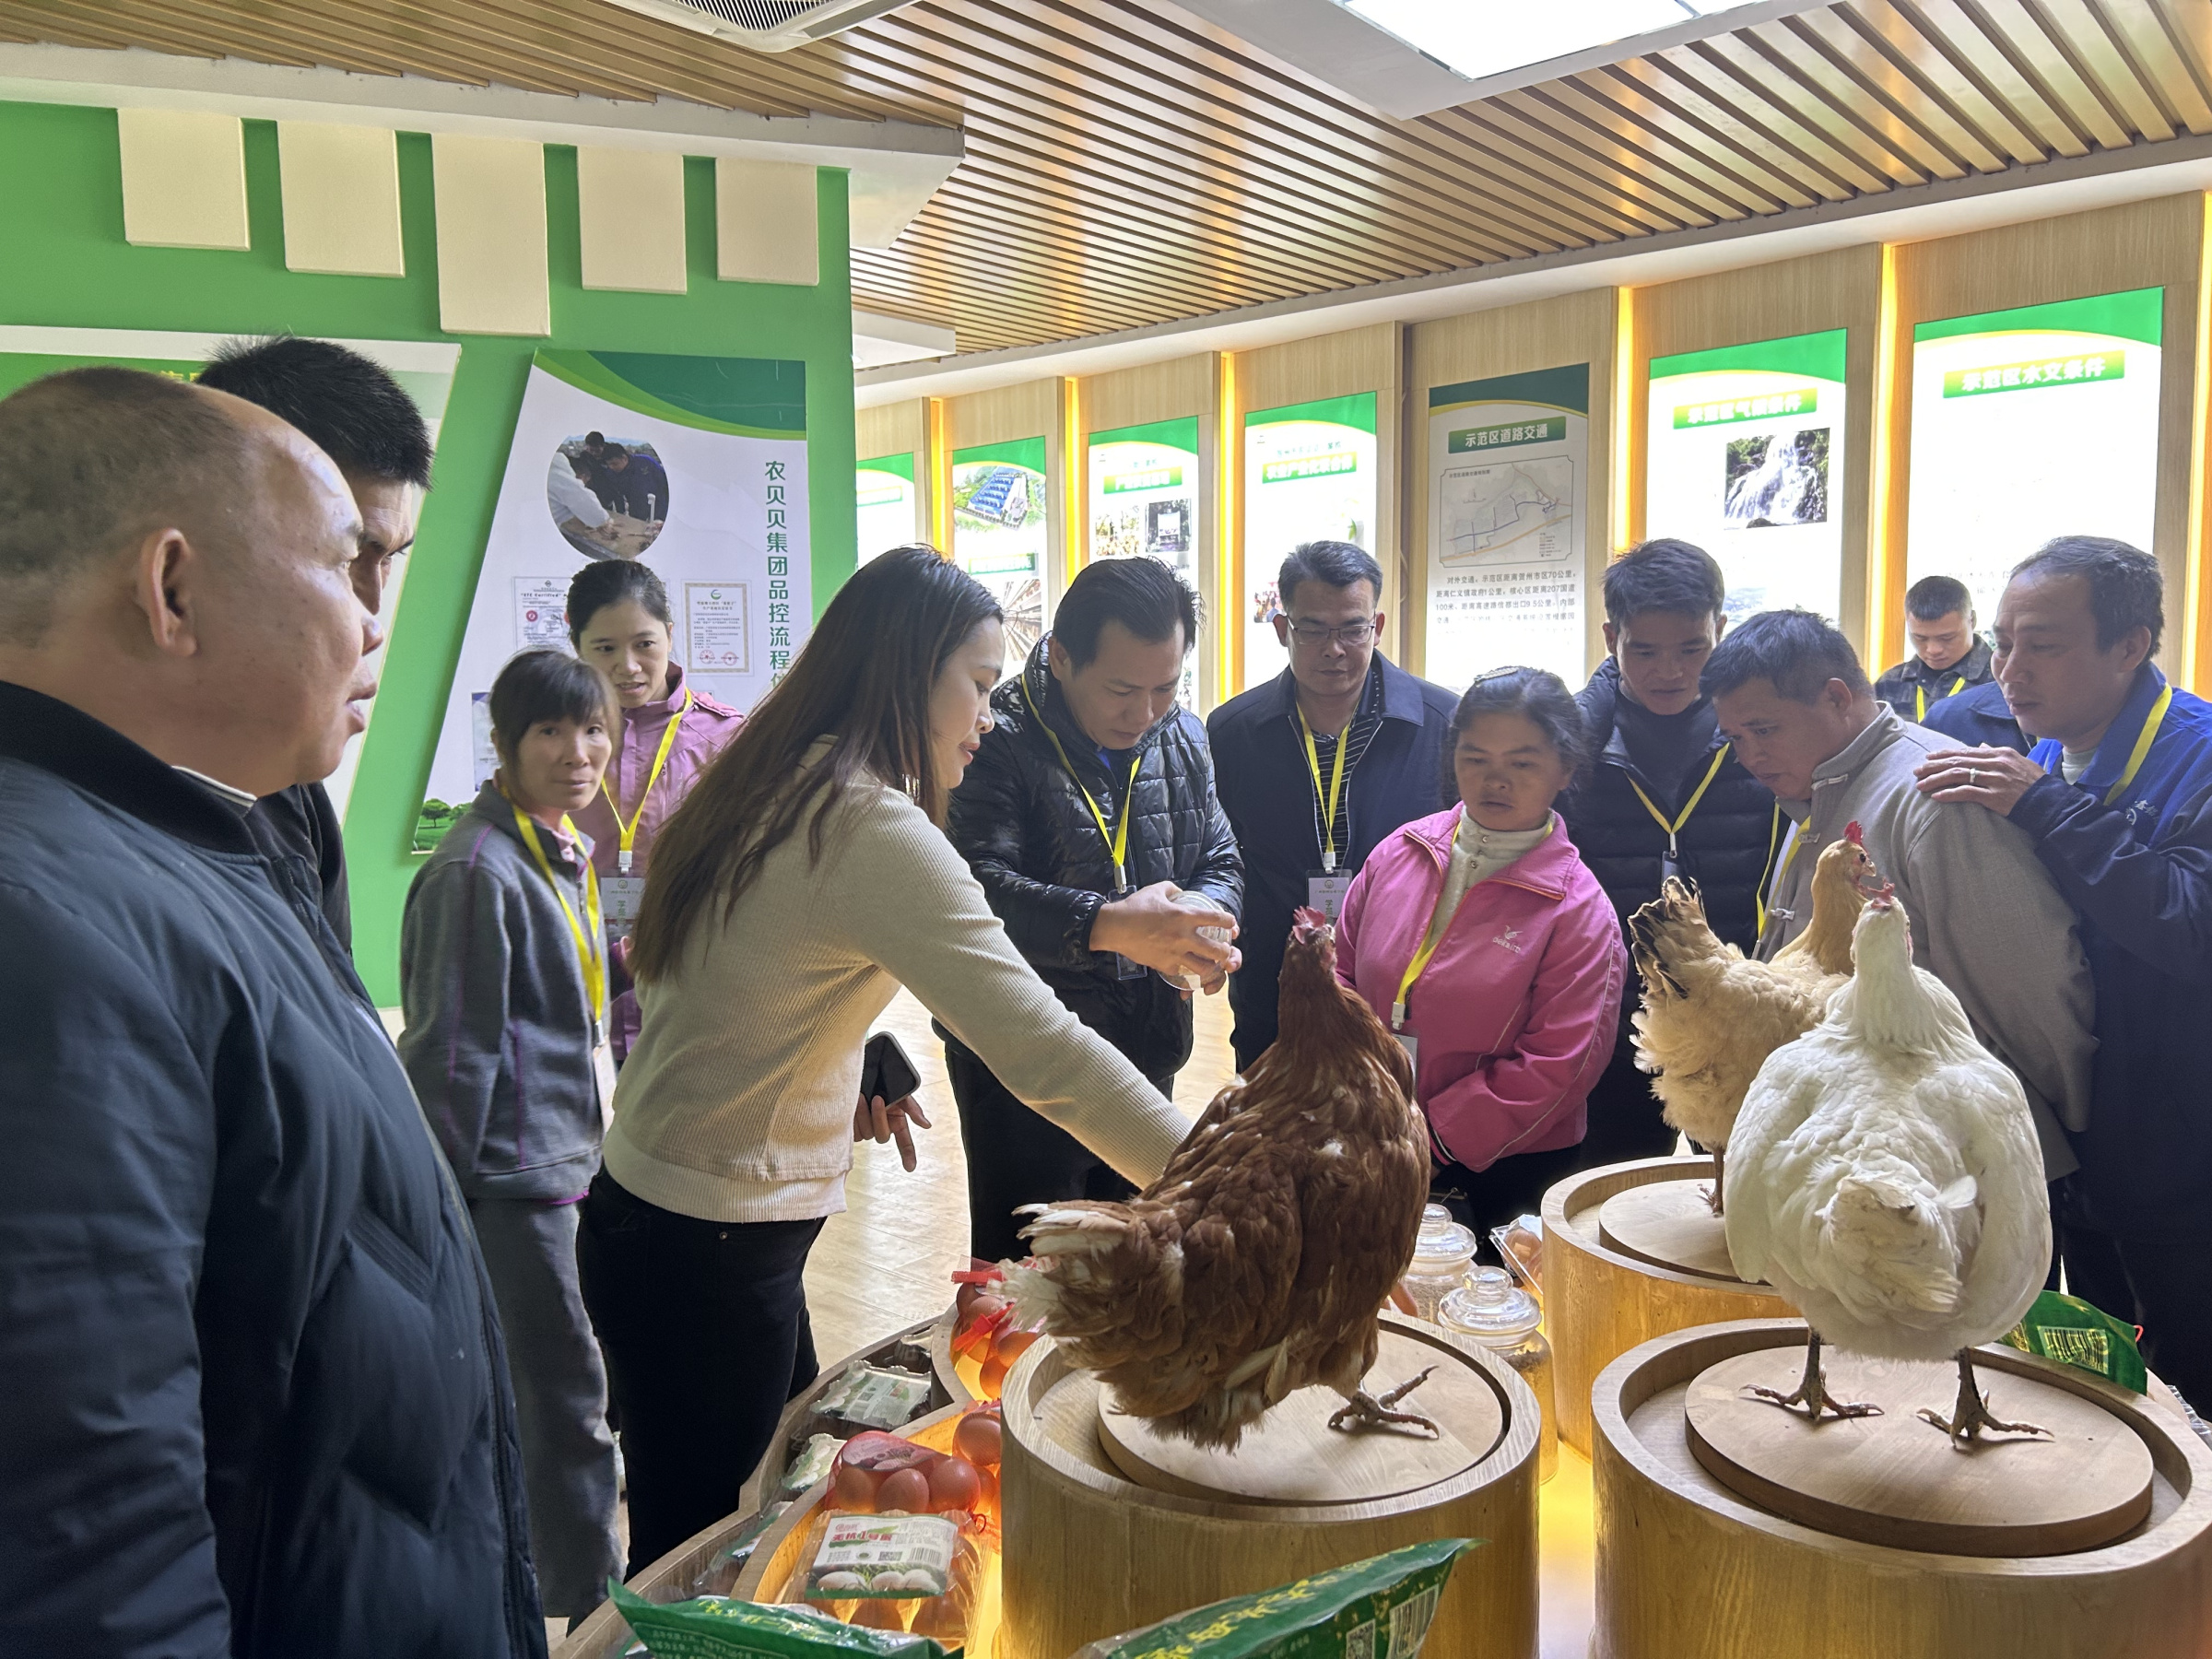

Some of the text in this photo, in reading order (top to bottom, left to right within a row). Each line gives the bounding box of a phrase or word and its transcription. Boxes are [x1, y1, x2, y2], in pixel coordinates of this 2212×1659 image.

[1961, 357, 2106, 392] 示范区水文条件
[1465, 423, 1547, 448] 示范区道路交通
